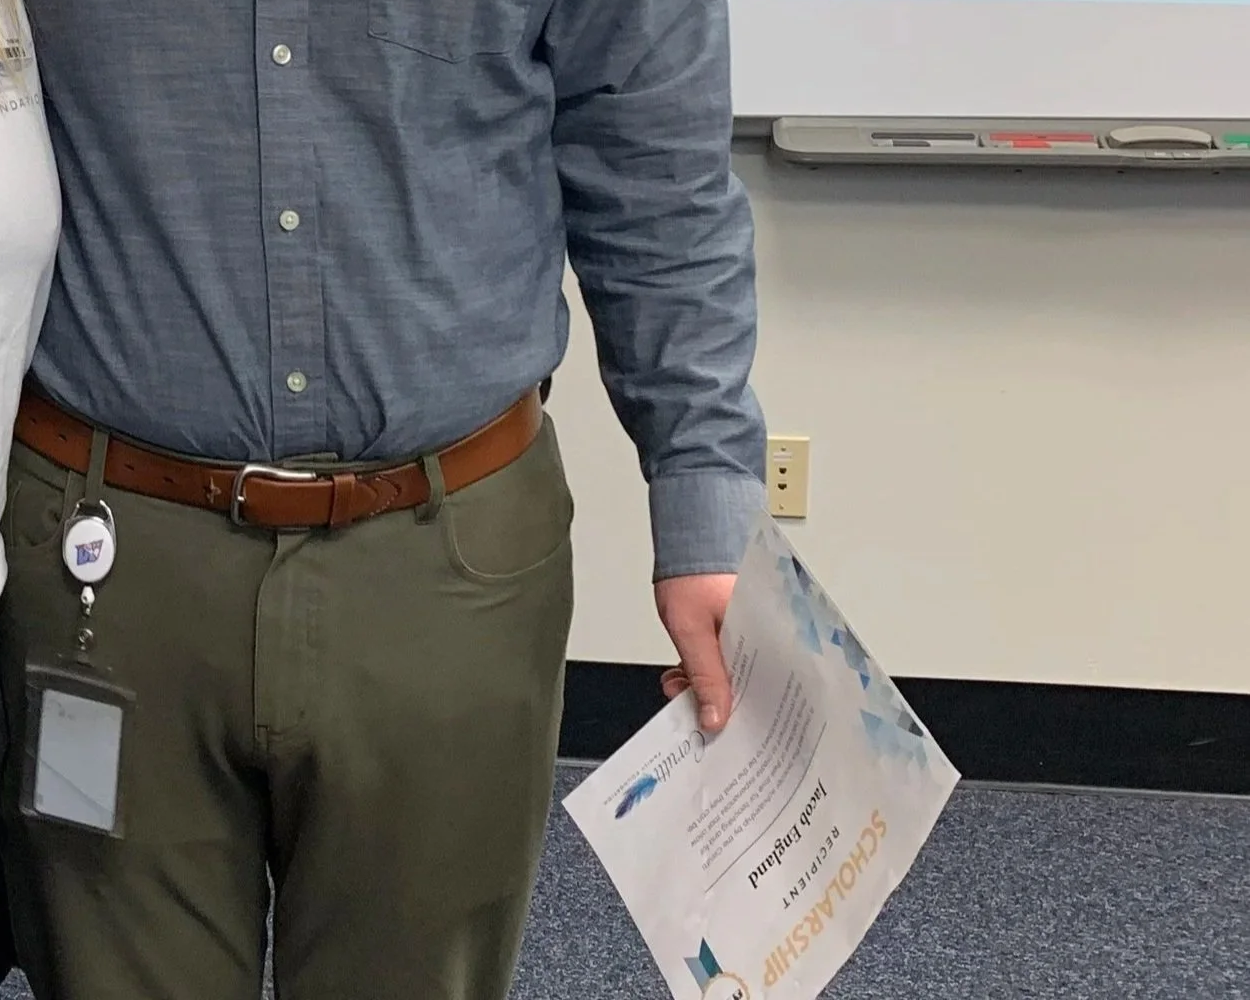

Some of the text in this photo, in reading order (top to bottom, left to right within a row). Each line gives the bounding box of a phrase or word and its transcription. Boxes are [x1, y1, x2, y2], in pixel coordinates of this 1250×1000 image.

[652, 729, 706, 786] Cerutti
[798, 776, 828, 826] Jacob
[746, 823, 802, 890] England
[781, 825, 840, 910] RECIPIENT
[763, 808, 890, 988] SCHOLARSHIP
